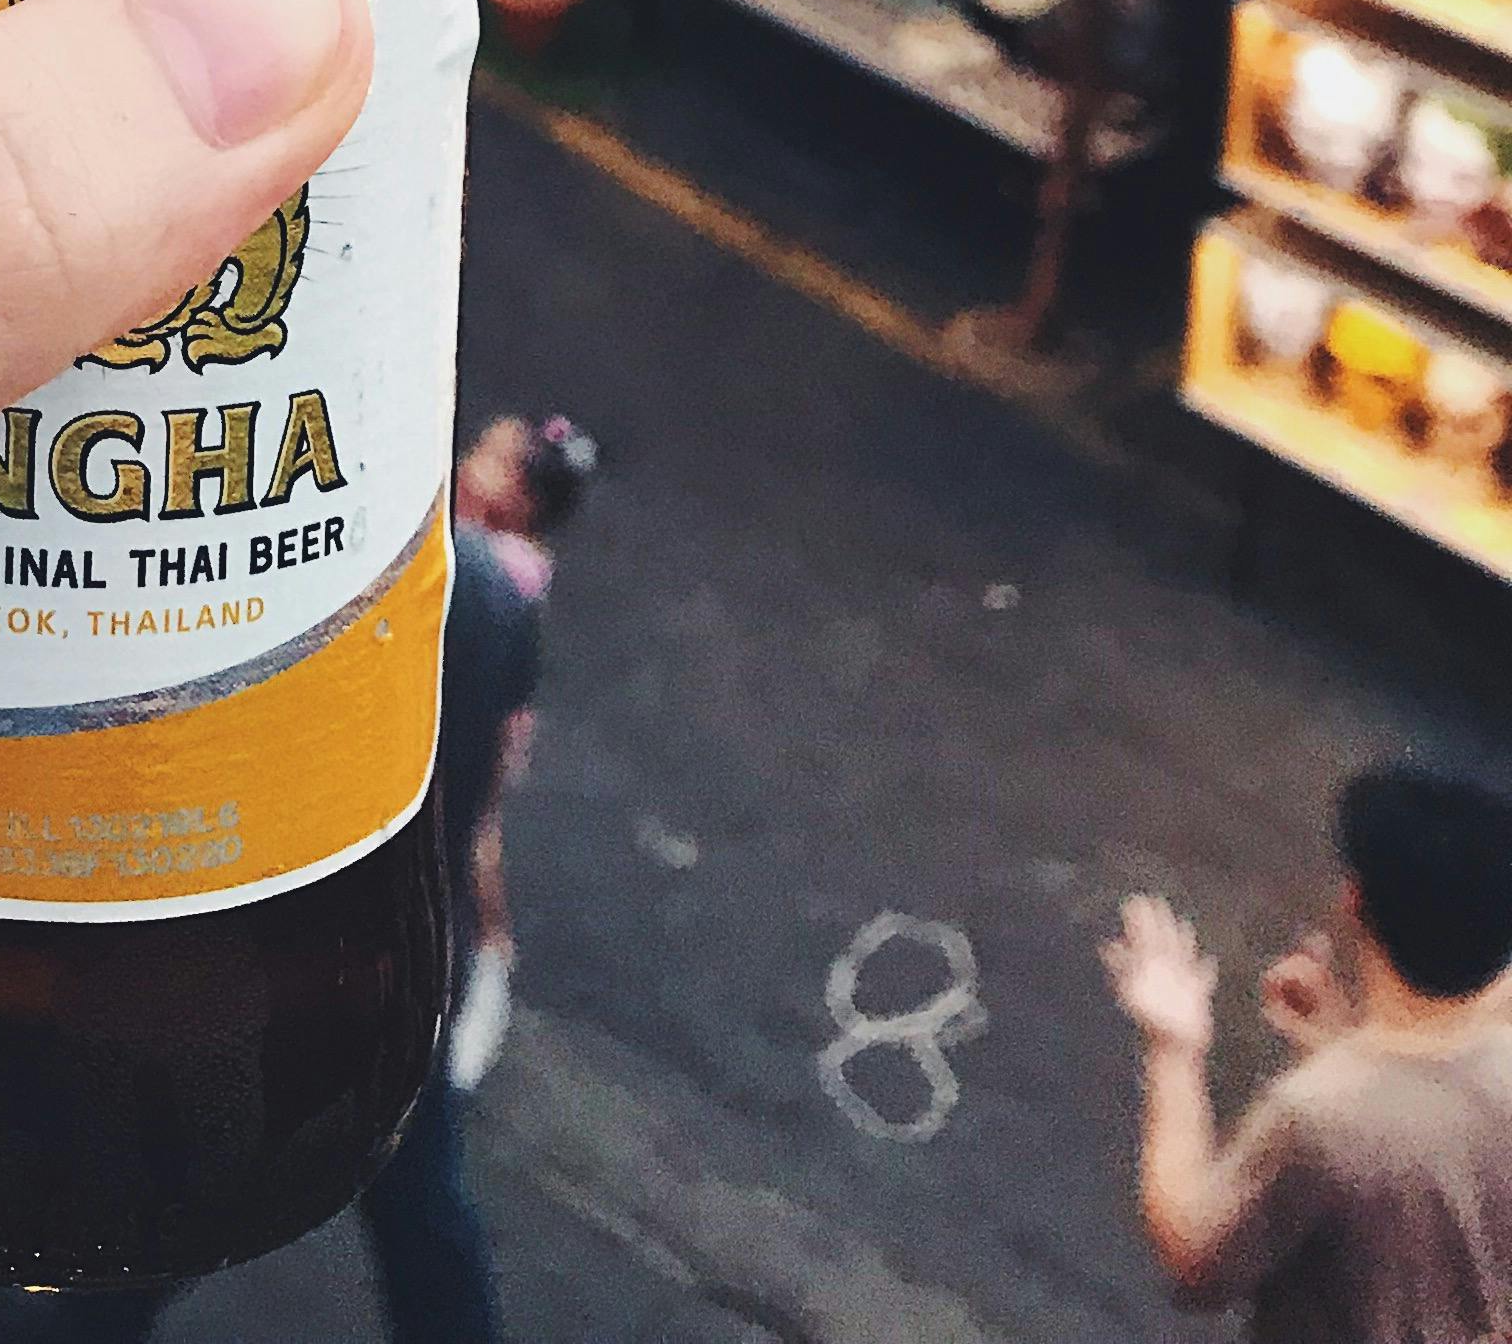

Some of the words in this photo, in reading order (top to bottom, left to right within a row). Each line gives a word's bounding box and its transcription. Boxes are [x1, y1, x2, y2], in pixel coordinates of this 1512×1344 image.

[129, 541, 229, 590] THAI
[248, 515, 346, 576] BEER
[87, 595, 266, 637] THAILAND
[815, 910, 988, 1143] 8
